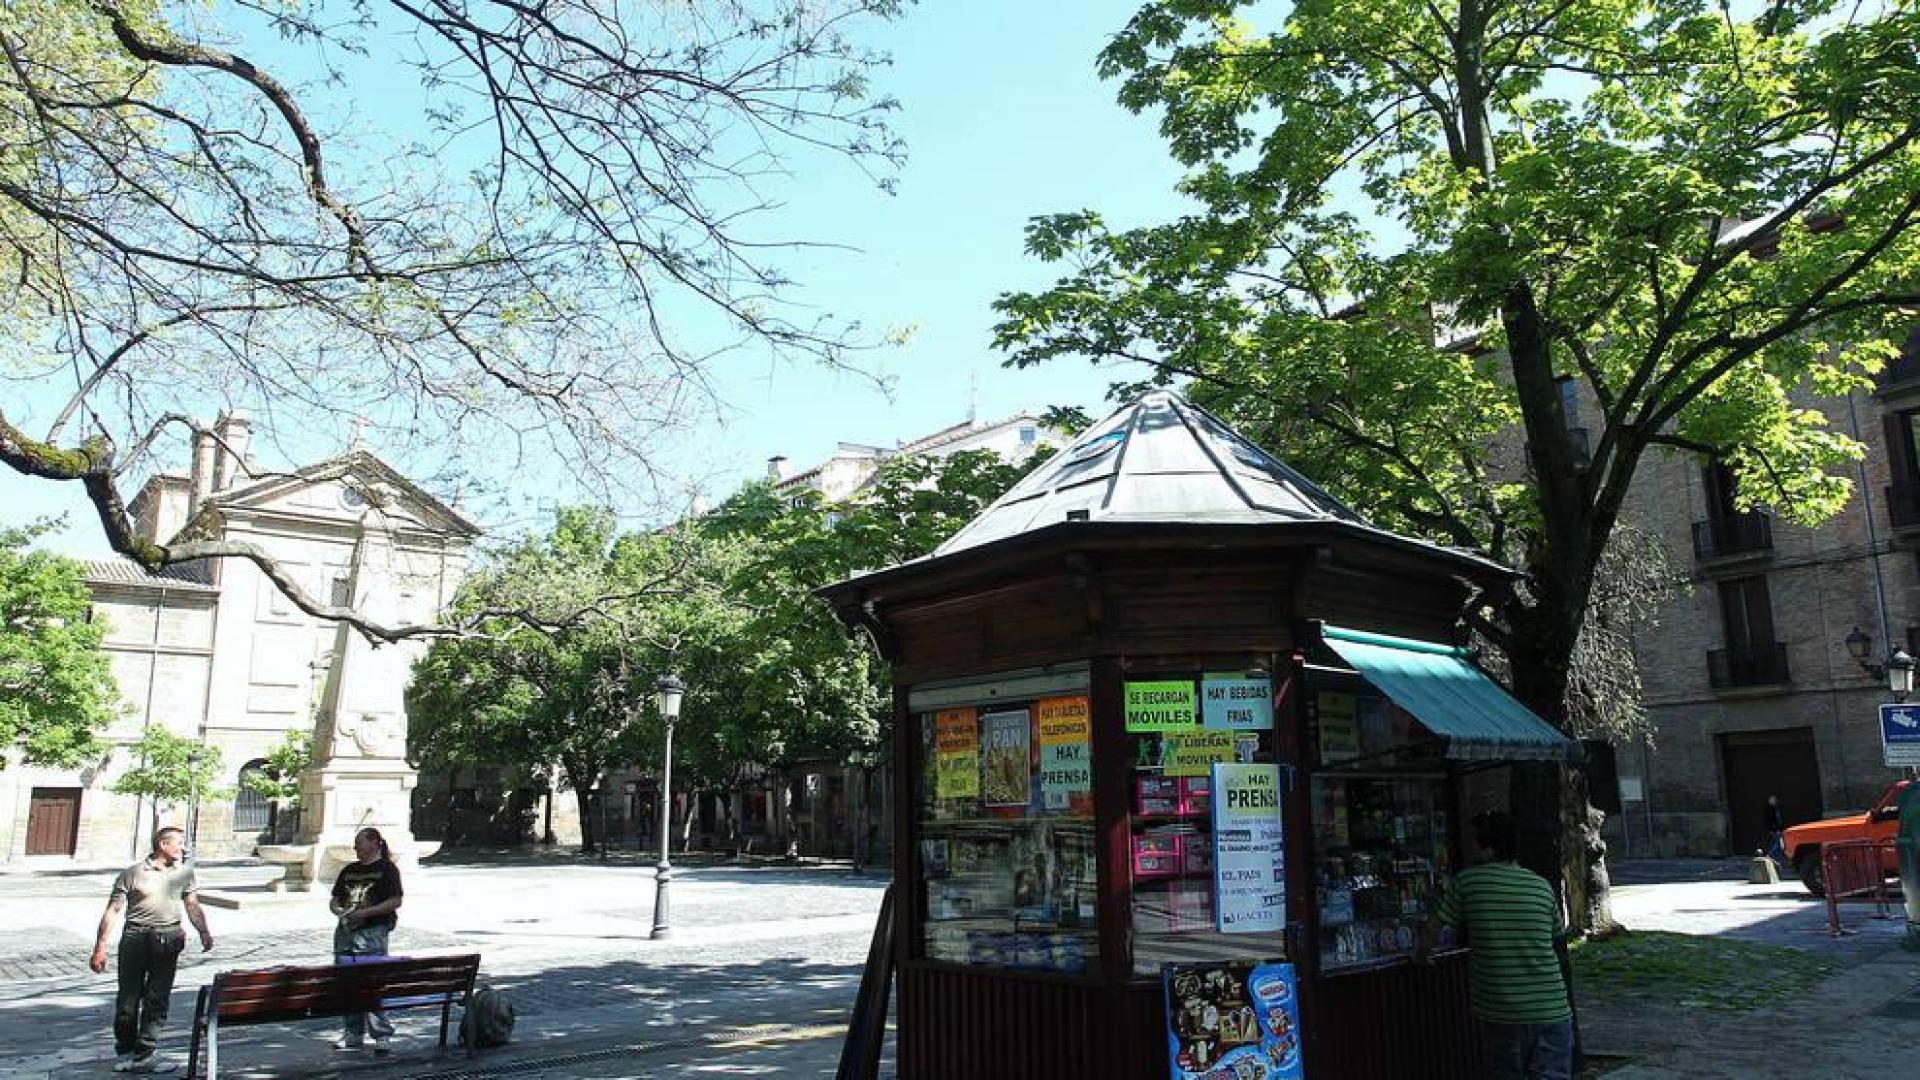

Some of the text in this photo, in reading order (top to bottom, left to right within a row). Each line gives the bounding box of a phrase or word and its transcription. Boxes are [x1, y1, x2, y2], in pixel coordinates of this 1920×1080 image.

[1130, 690, 1190, 704] SE RECARGAN
[1208, 686, 1268, 700] HAY BEBIDAS
[1056, 746, 1081, 760] HAY
[1041, 770, 1088, 785] PRENSA
[1248, 774, 1270, 786] HAY
